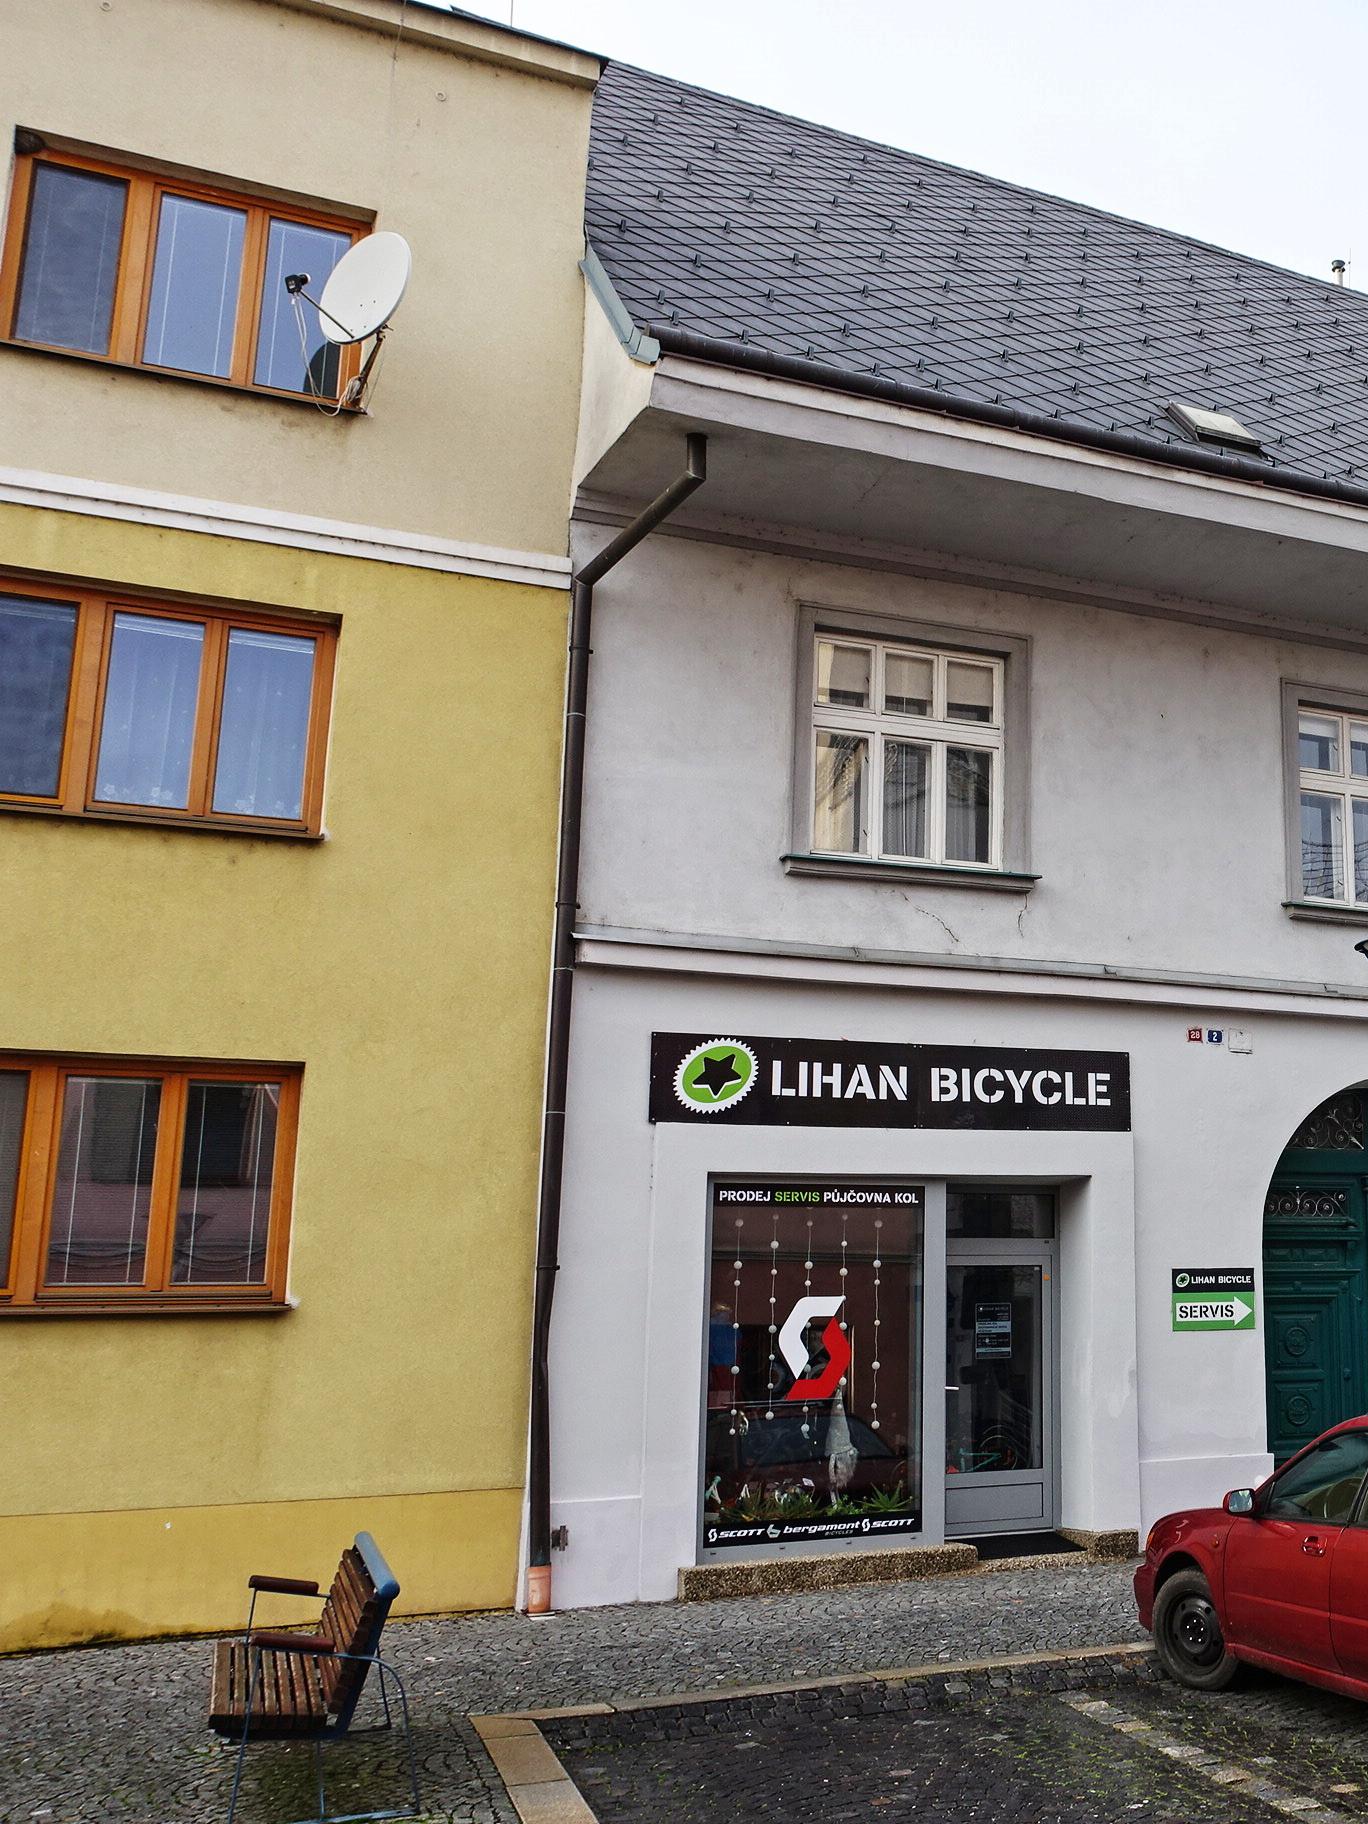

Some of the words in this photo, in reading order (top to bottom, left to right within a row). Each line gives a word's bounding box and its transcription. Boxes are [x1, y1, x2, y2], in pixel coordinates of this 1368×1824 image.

[1190, 1030, 1200, 1039] 28
[1212, 1032, 1218, 1041] 2
[771, 1060, 908, 1101] LIHAN
[931, 1067, 1111, 1106] BICYCLE
[719, 1190, 770, 1202] PRODEJ
[774, 1191, 820, 1202] SERVIS
[824, 1189, 891, 1204] PŮJČOVNA
[894, 1193, 919, 1204] KOL
[1191, 1276, 1215, 1284] LIHAN
[1218, 1276, 1251, 1284] BICYCLE
[1179, 1304, 1234, 1318] SERVIS
[718, 1528, 765, 1538] SCOTT
[783, 1520, 860, 1534] bergamont
[870, 1518, 915, 1528] SCOTT
